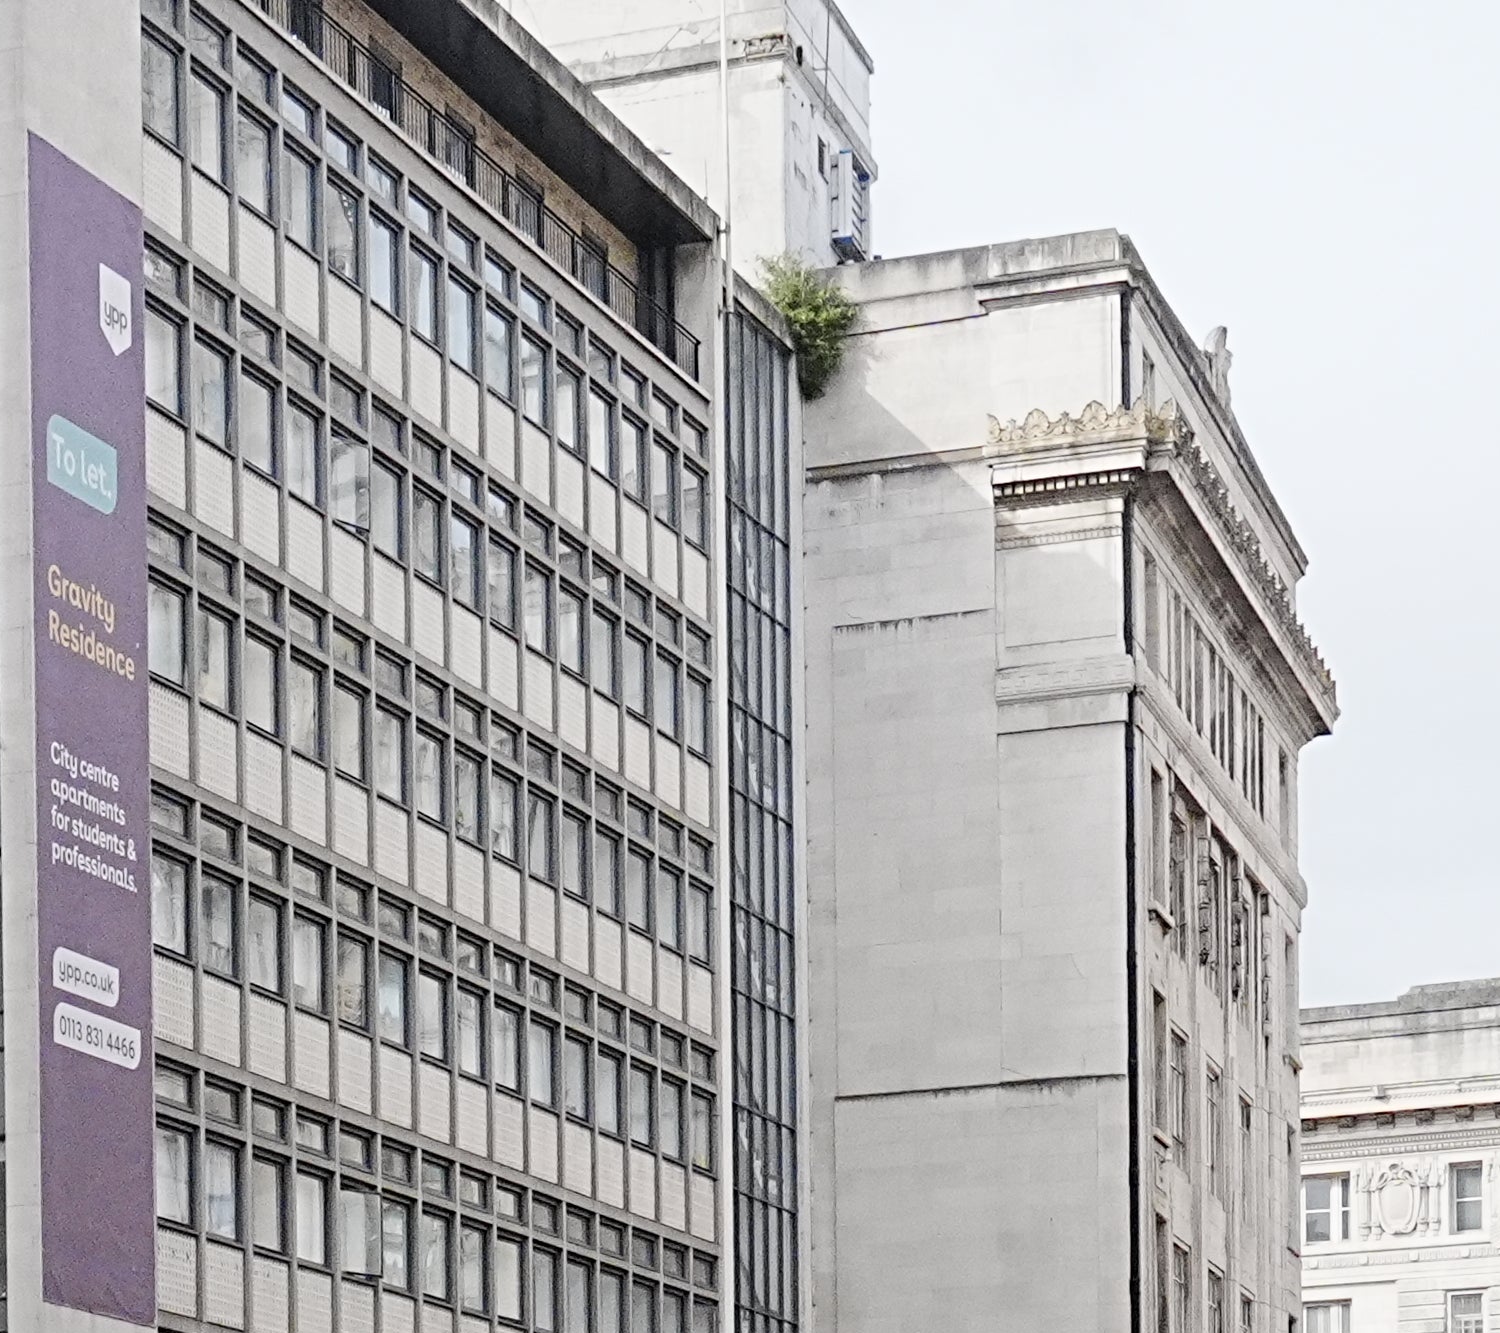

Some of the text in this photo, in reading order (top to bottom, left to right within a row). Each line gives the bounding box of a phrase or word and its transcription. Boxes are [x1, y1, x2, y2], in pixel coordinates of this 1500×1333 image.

[104, 301, 128, 335] ypp
[51, 433, 113, 499] To let.
[48, 564, 115, 634] Gravity
[48, 608, 136, 681] Residence
[50, 741, 120, 792] City centre
[50, 778, 127, 826] apartments
[50, 804, 137, 861] for students &
[51, 842, 138, 893] professionals.
[58, 960, 115, 995] ypp.co.uk
[59, 1015, 136, 1060] 0113 831 4466
